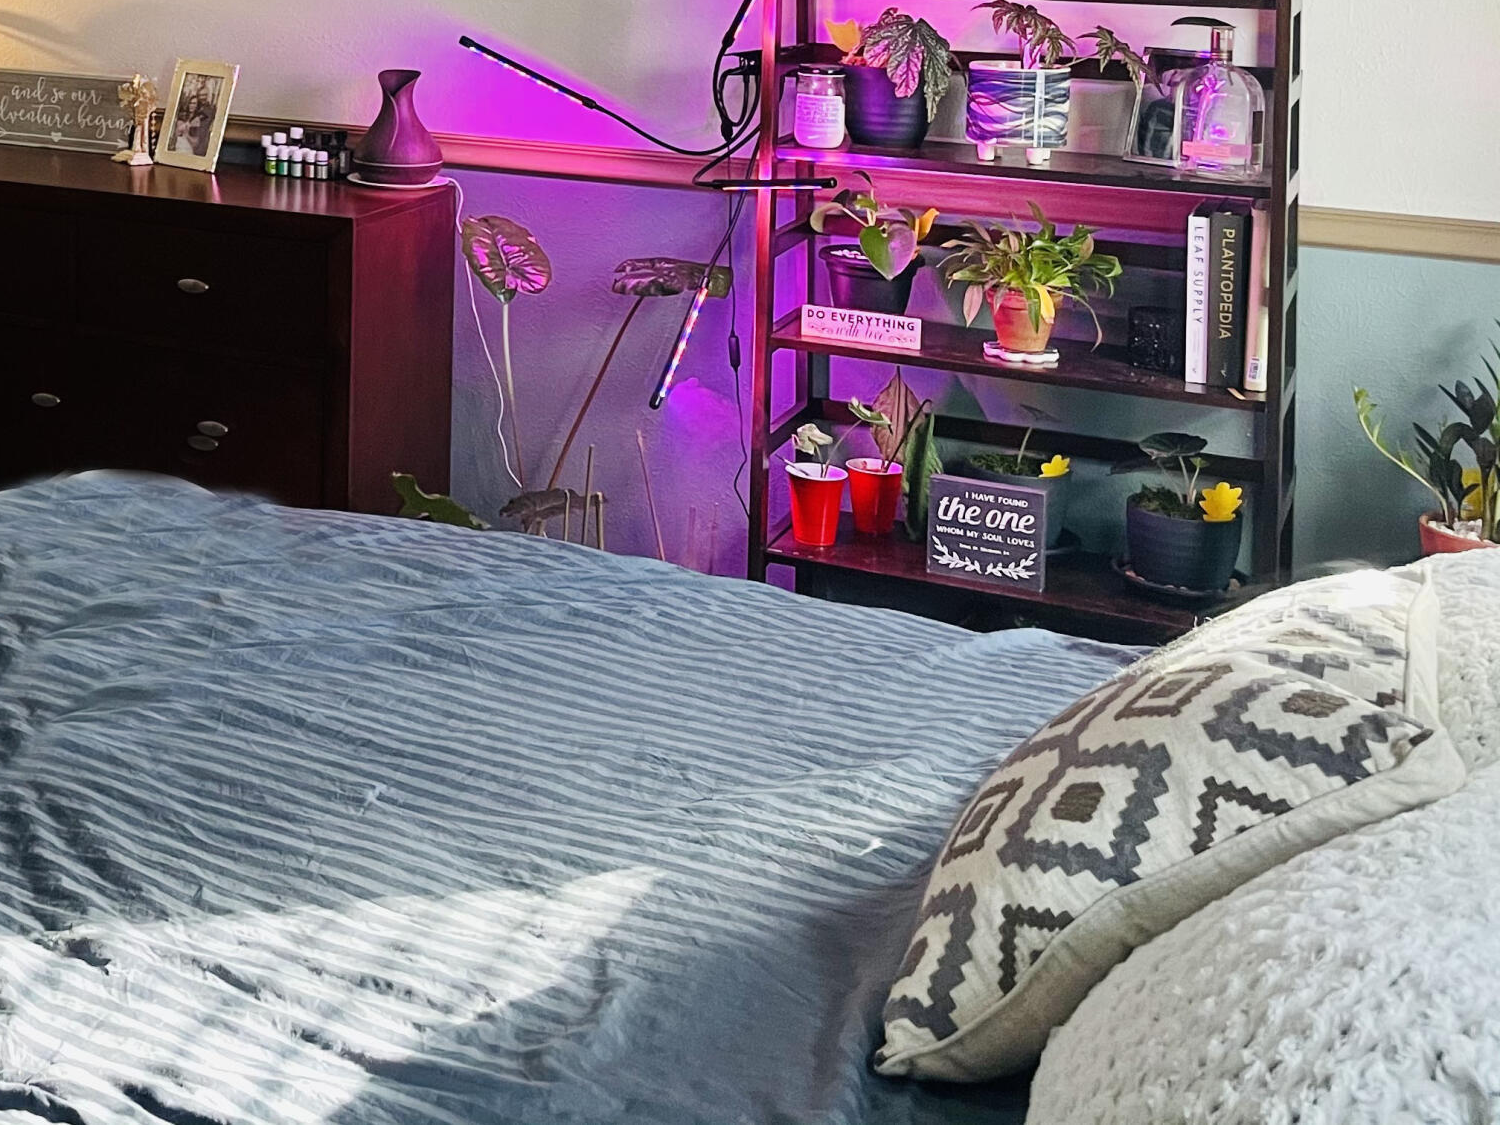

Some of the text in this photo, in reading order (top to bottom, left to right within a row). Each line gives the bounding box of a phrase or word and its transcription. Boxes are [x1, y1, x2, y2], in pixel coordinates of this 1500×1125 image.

[11, 77, 101, 105] and so our
[1193, 226, 1204, 264] LEAF
[1193, 271, 1204, 324] SUPPLY
[1218, 227, 1236, 340] PLANTOPEDIA
[807, 309, 915, 331] DO EVERYTHING
[937, 496, 1036, 534] the one
[971, 492, 996, 503] HAVE
[998, 496, 1029, 508] FOUND
[936, 524, 1035, 548] WHOM MY SOUL LOVES
